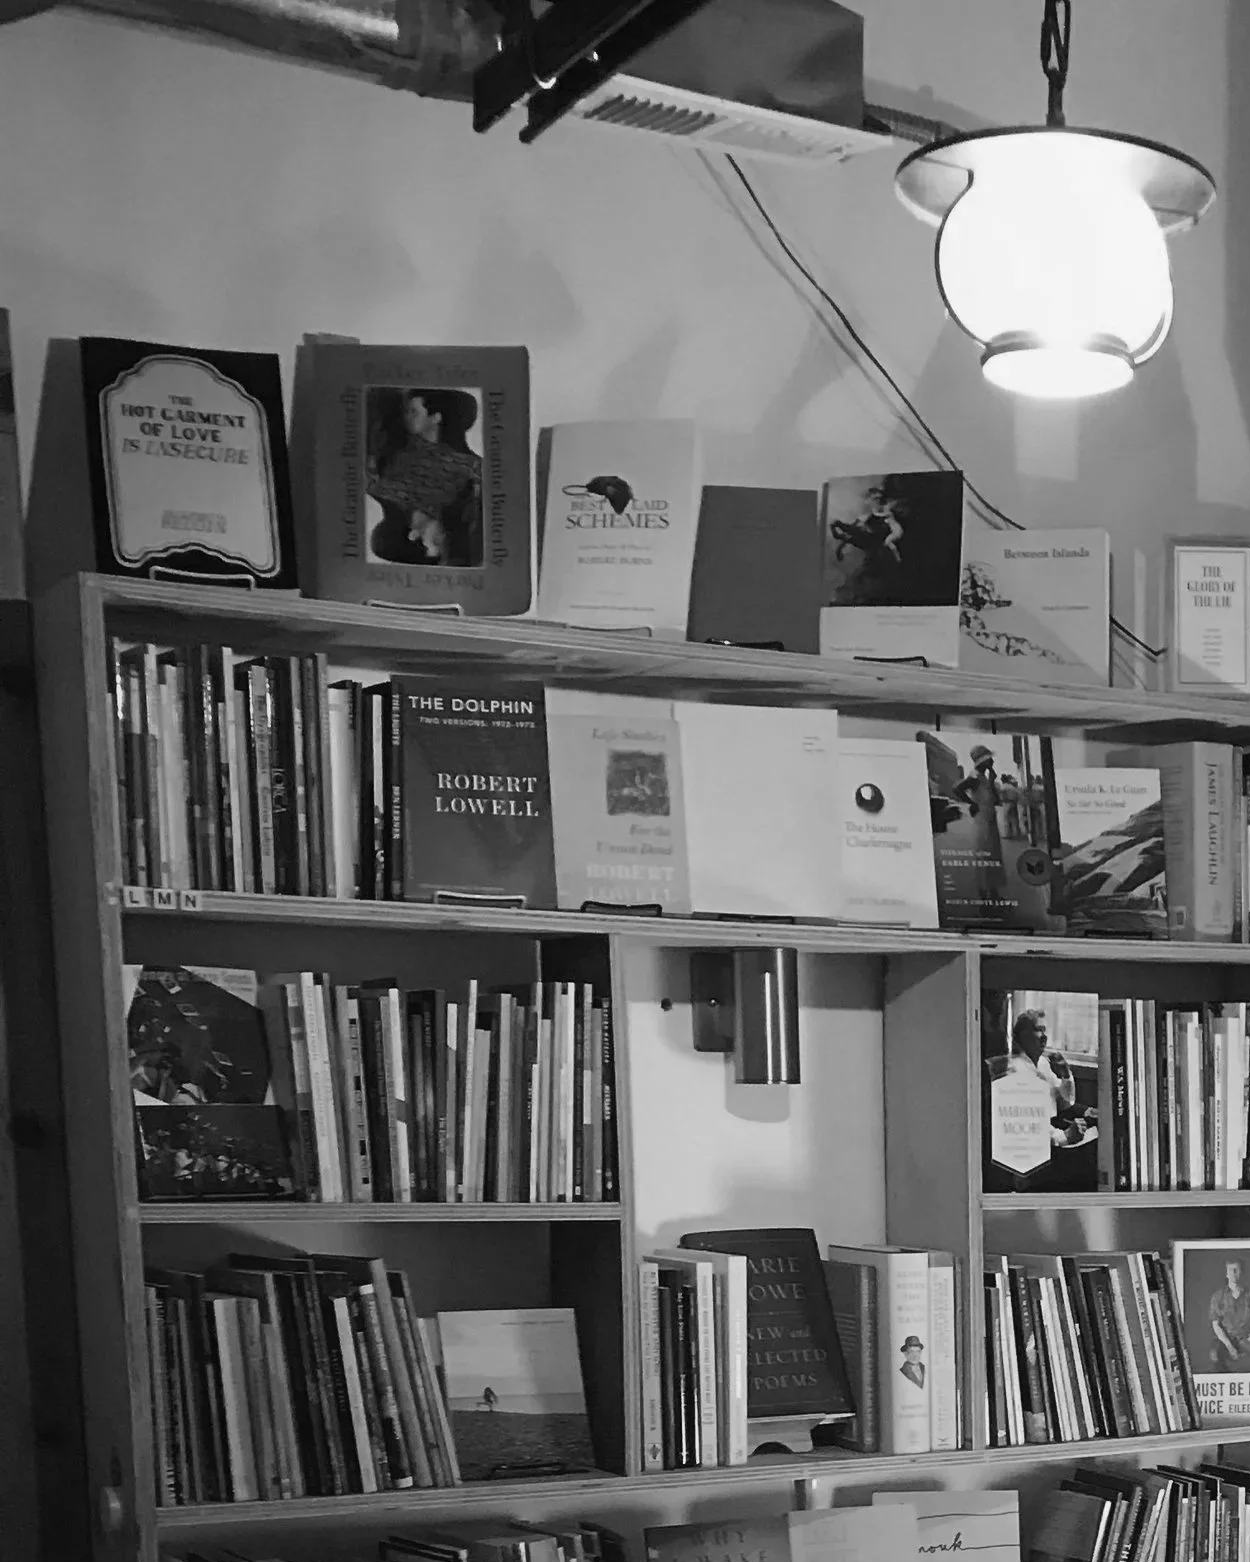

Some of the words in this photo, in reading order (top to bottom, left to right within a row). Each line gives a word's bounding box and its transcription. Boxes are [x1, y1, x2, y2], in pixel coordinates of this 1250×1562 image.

[168, 394, 193, 406] THE
[121, 404, 156, 419] HOT
[160, 408, 246, 428] GARMENT
[139, 422, 164, 437] OF
[171, 425, 223, 443] LOVE
[121, 438, 141, 453] IS
[631, 499, 669, 511] LAID
[565, 513, 670, 529] SCHEMES
[392, 694, 400, 711] THE
[408, 695, 444, 711] THE
[452, 698, 533, 714] DOLPHIN
[419, 716, 440, 724] TWO
[272, 767, 288, 814] LORCA
[437, 772, 538, 794] ROBERT
[1203, 762, 1219, 807] JAMES
[434, 796, 539, 817] LOWELL
[1207, 810, 1220, 886] LAUGHLIN
[130, 890, 139, 905] L
[158, 892, 171, 905] M
[185, 894, 197, 908] N
[748, 1256, 801, 1274] ARIE
[749, 1283, 806, 1301] OWE
[749, 1348, 828, 1366] LECTED
[753, 1374, 818, 1391] POEMS
[1229, 1382, 1245, 1396] BE
[690, 1529, 748, 1546] WHY
